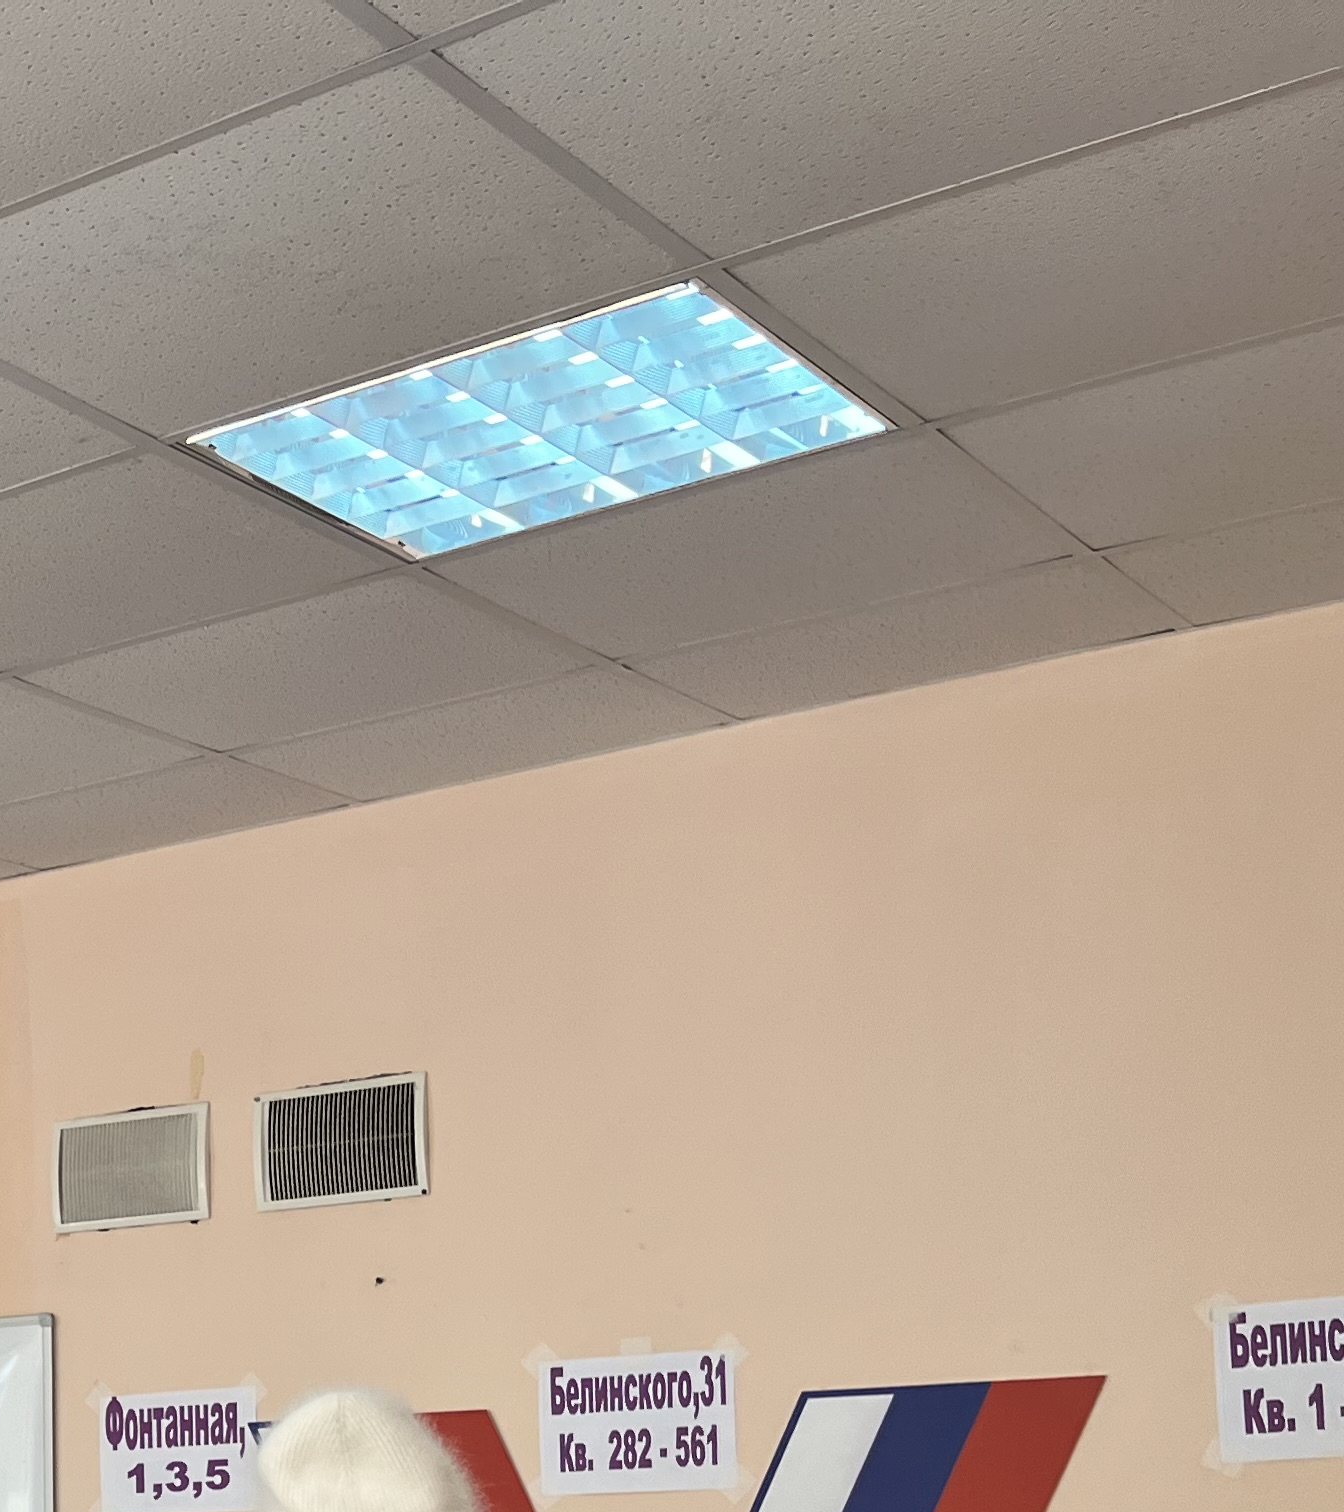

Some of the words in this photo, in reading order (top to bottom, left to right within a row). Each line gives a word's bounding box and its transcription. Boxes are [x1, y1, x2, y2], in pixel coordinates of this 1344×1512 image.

[550, 1354, 727, 1419] Белинского,31
[1243, 1388, 1296, 1435] Кв.
[1308, 1383, 1325, 1430] 1
[105, 1396, 246, 1459] Фонтанная,
[559, 1432, 594, 1473] Кв.
[608, 1428, 653, 1470] 282
[675, 1424, 718, 1467] 561
[127, 1459, 230, 1500] 1,3,5
